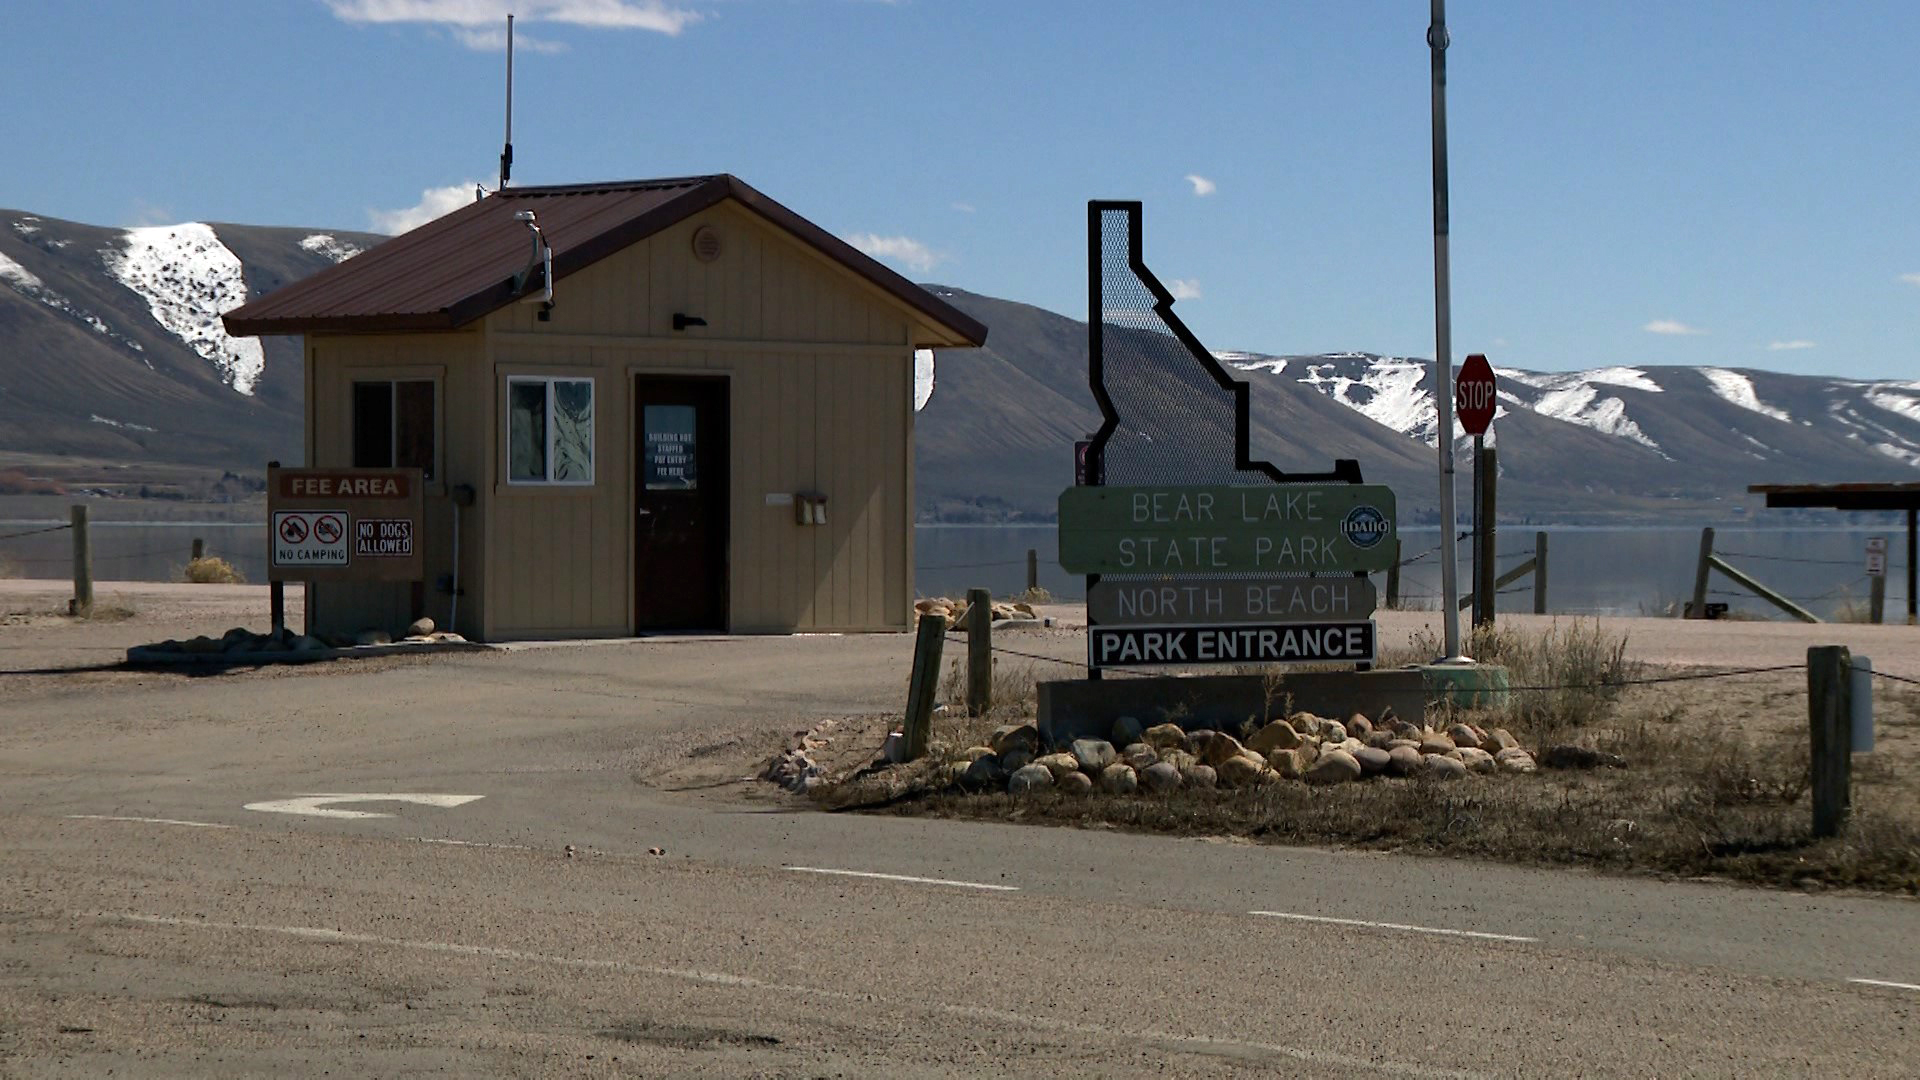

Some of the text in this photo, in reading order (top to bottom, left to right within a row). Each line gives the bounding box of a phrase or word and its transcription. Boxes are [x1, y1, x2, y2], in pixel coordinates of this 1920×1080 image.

[1459, 381, 1493, 410] STOP
[648, 433, 678, 441] BUILDING
[657, 467, 668, 475] FEE
[291, 478, 399, 495] FEE AREA
[1132, 492, 1215, 523] BEAR
[1241, 491, 1324, 522] LAKE
[359, 523, 409, 538] NO DOGS
[1343, 520, 1388, 533] IDAHO
[359, 539, 410, 553] ALLOWED
[1118, 536, 1338, 568] STATE PARK
[279, 549, 345, 560] NO CAMPING
[1118, 585, 1350, 618] NORTH BEACH
[1101, 627, 1364, 663] PARK ENTRANCE
